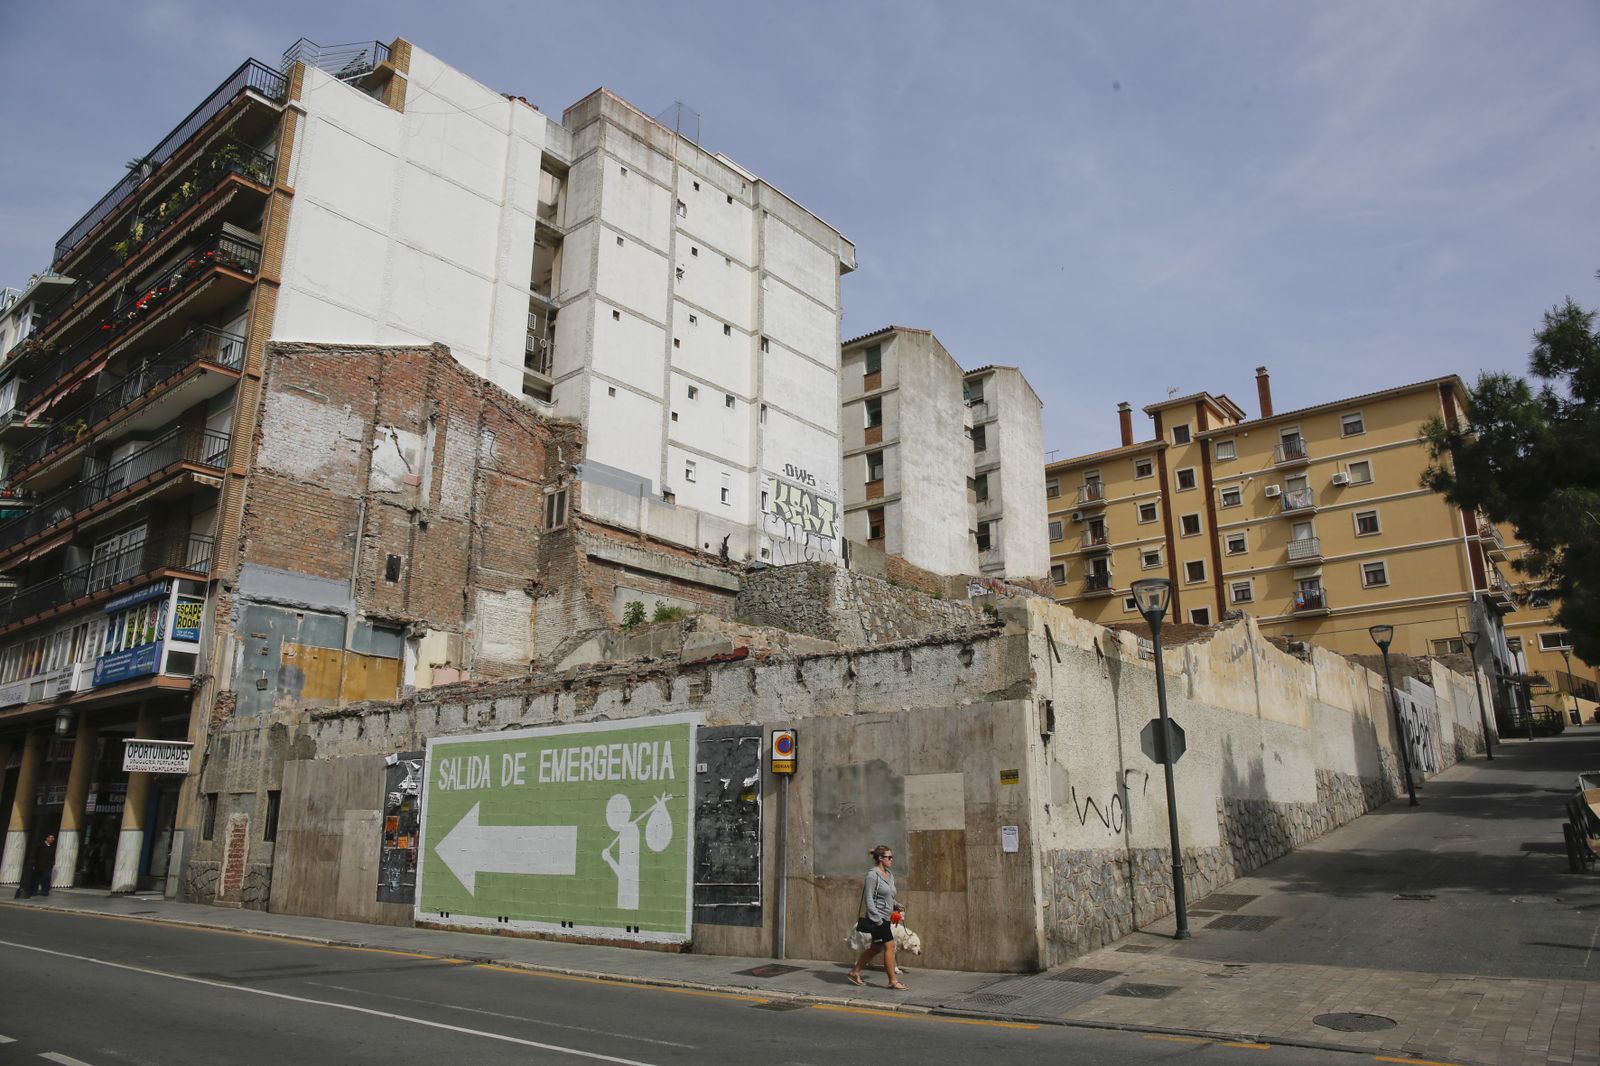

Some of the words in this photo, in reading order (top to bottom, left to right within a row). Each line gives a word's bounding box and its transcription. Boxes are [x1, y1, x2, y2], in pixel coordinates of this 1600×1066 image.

[176, 603, 203, 620] ESCAPE
[176, 615, 201, 628] ROOM
[127, 744, 190, 761] OPORTUNIDADES
[438, 755, 491, 791] SALIDA
[501, 752, 527, 787] DE
[538, 741, 676, 784] EMERGENCIA
